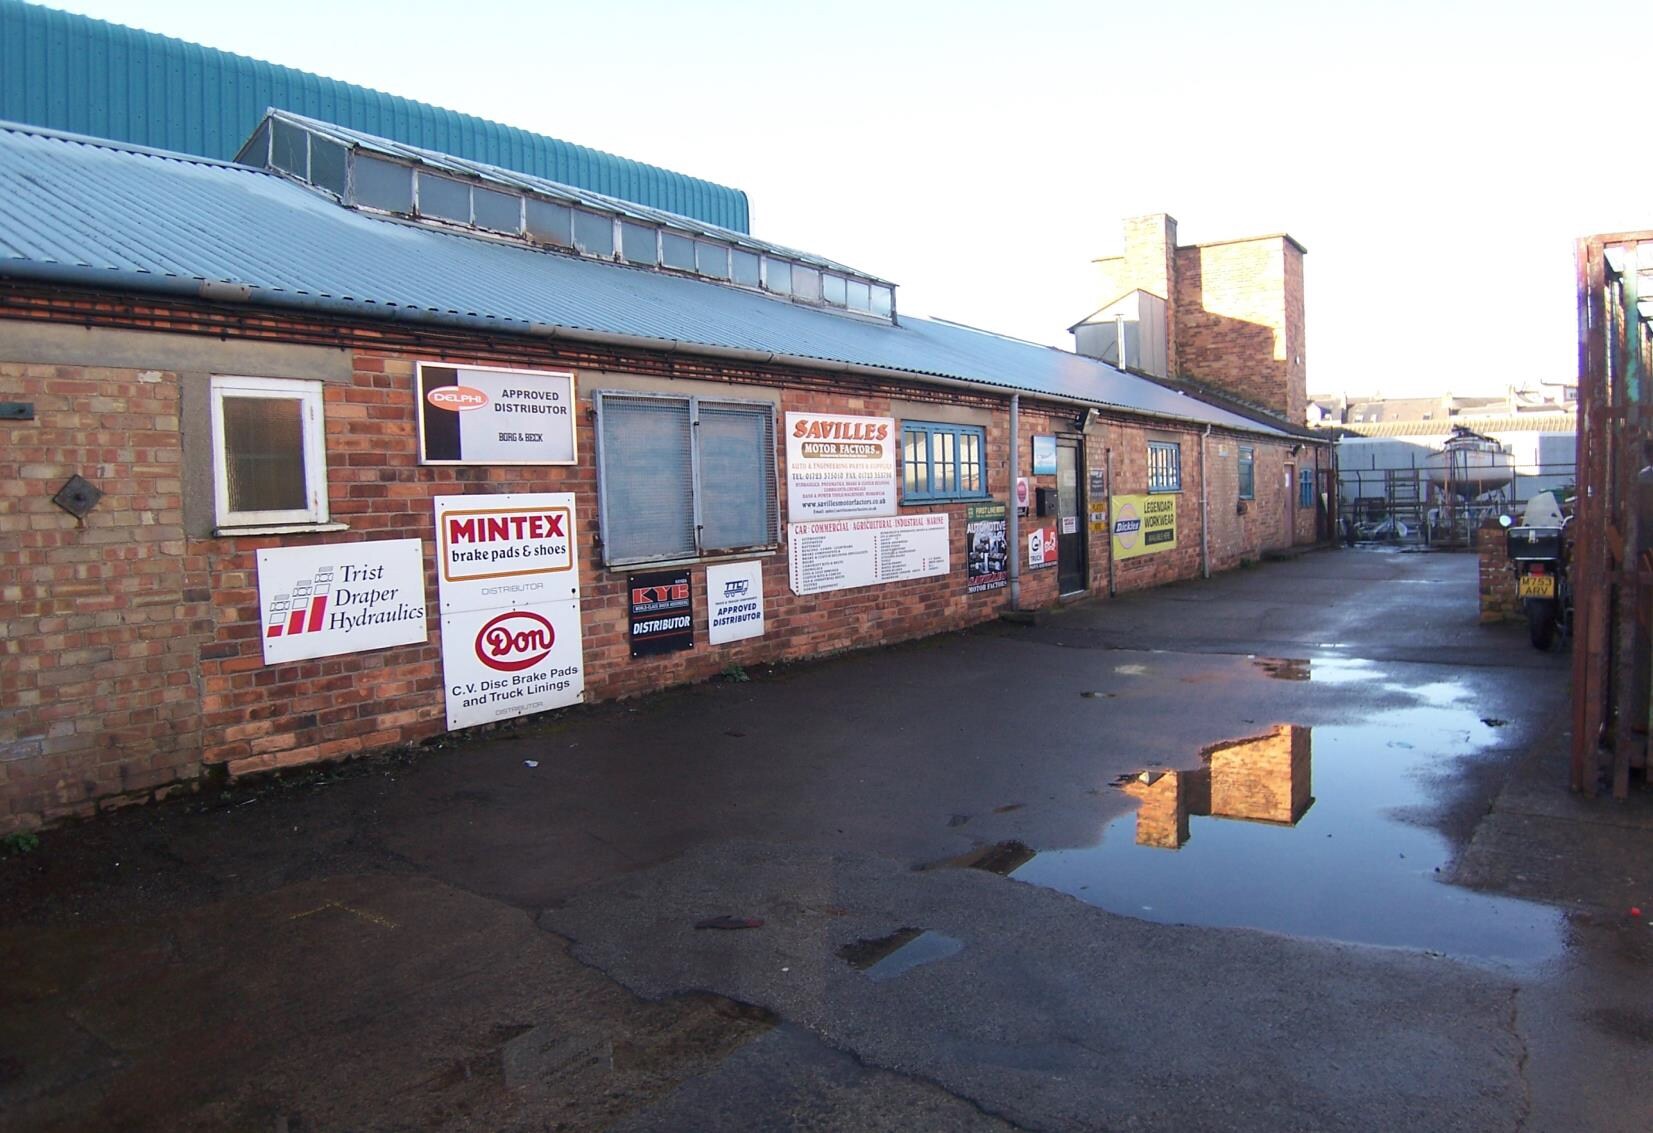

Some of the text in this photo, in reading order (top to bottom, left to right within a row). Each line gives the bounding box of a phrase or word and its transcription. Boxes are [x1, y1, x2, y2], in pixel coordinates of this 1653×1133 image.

[434, 393, 482, 404] DELPHI
[502, 389, 559, 401] APPROVED
[494, 403, 568, 415] DISTRIBUTOR
[518, 432, 524, 442] &
[792, 419, 889, 441] SAVILLES
[804, 443, 876, 455] MOTOR FACTORS
[1144, 501, 1174, 514] LEGENDARY
[794, 524, 807, 535] CAR
[810, 521, 849, 534] COMMERCIAL
[852, 518, 893, 532] AGRICULTURAL
[1115, 521, 1140, 533] Dickies
[1144, 514, 1174, 528] WORKWEAR
[450, 514, 565, 545] MINTEX
[452, 544, 566, 562] brake pads & shoes
[340, 564, 384, 583] Trist
[481, 582, 544, 595] DISTRIBUTOR
[632, 583, 689, 605] KYB
[335, 588, 399, 608] Draper
[717, 602, 757, 616] APPROVED
[328, 603, 424, 633] Hydraulics
[632, 616, 690, 635] DISTRIBUTOR
[713, 611, 761, 627] DISTRIBUTOR
[486, 626, 551, 657] Don
[452, 666, 578, 697] C.V. Disc Brake Pads
[462, 679, 570, 708] and Truck Linings
[495, 701, 544, 716] DISTRIBUTOR
